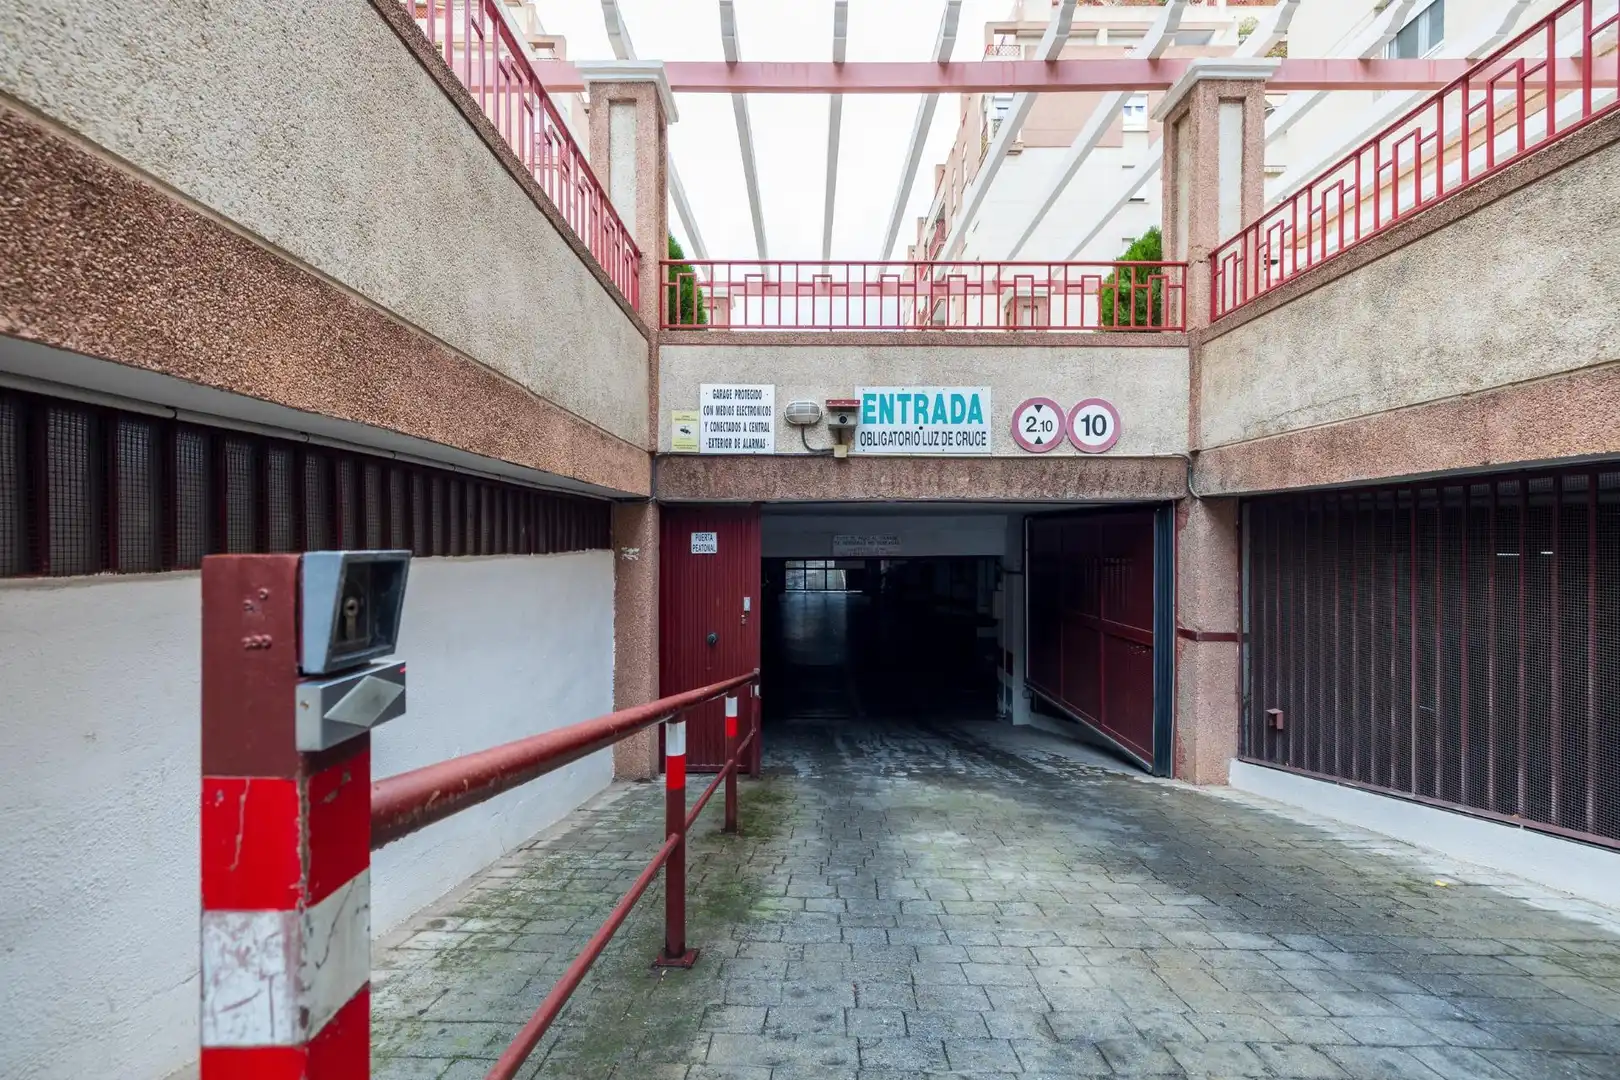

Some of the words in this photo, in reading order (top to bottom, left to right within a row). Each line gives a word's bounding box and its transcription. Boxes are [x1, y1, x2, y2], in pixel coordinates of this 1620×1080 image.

[712, 389, 732, 400] GARAGE
[734, 389, 763, 400] PROTEGIDO
[703, 405, 714, 416] CON
[715, 405, 735, 416] MEDIOS
[736, 405, 772, 416] ELECTRONICOS
[862, 393, 984, 425] ENTRADA
[704, 422, 709, 432] Y
[709, 422, 741, 432] CONECTADOS
[743, 422, 747, 432] A
[749, 422, 770, 432] CENTRAL
[1026, 416, 1053, 433] 2.10
[1081, 414, 1107, 436] 10
[708, 438, 732, 449] EXTERIOR
[734, 438, 741, 449] DE
[742, 438, 766, 449] ALARMAS
[860, 431, 921, 446] OBLIGATORIO
[922, 431, 939, 446] LUZ
[941, 431, 953, 446] DE
[955, 431, 987, 446] CRUCE
[695, 533, 714, 541] PUERTA
[692, 544, 717, 552] PEATONAL
